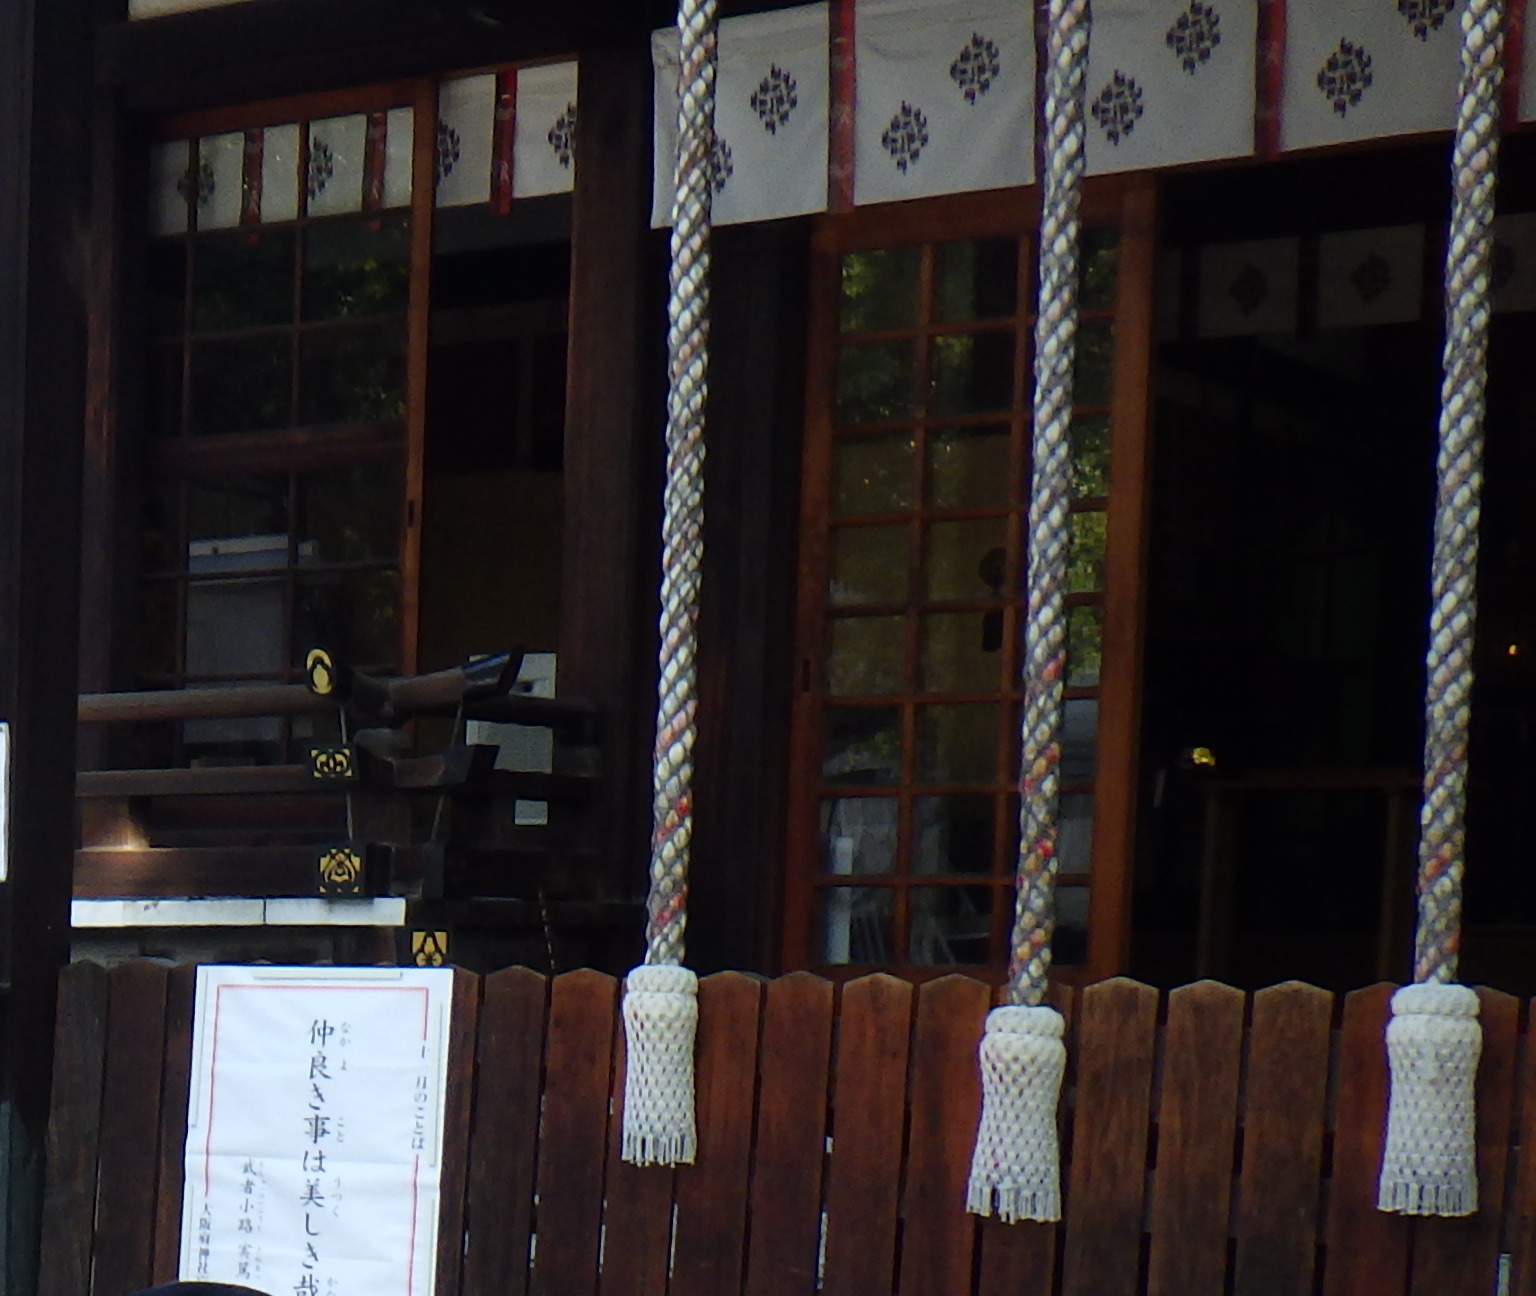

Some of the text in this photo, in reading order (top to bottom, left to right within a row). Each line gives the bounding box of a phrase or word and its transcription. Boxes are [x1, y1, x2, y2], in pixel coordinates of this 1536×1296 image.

[197, 1202, 212, 1280] 大阪府神社
